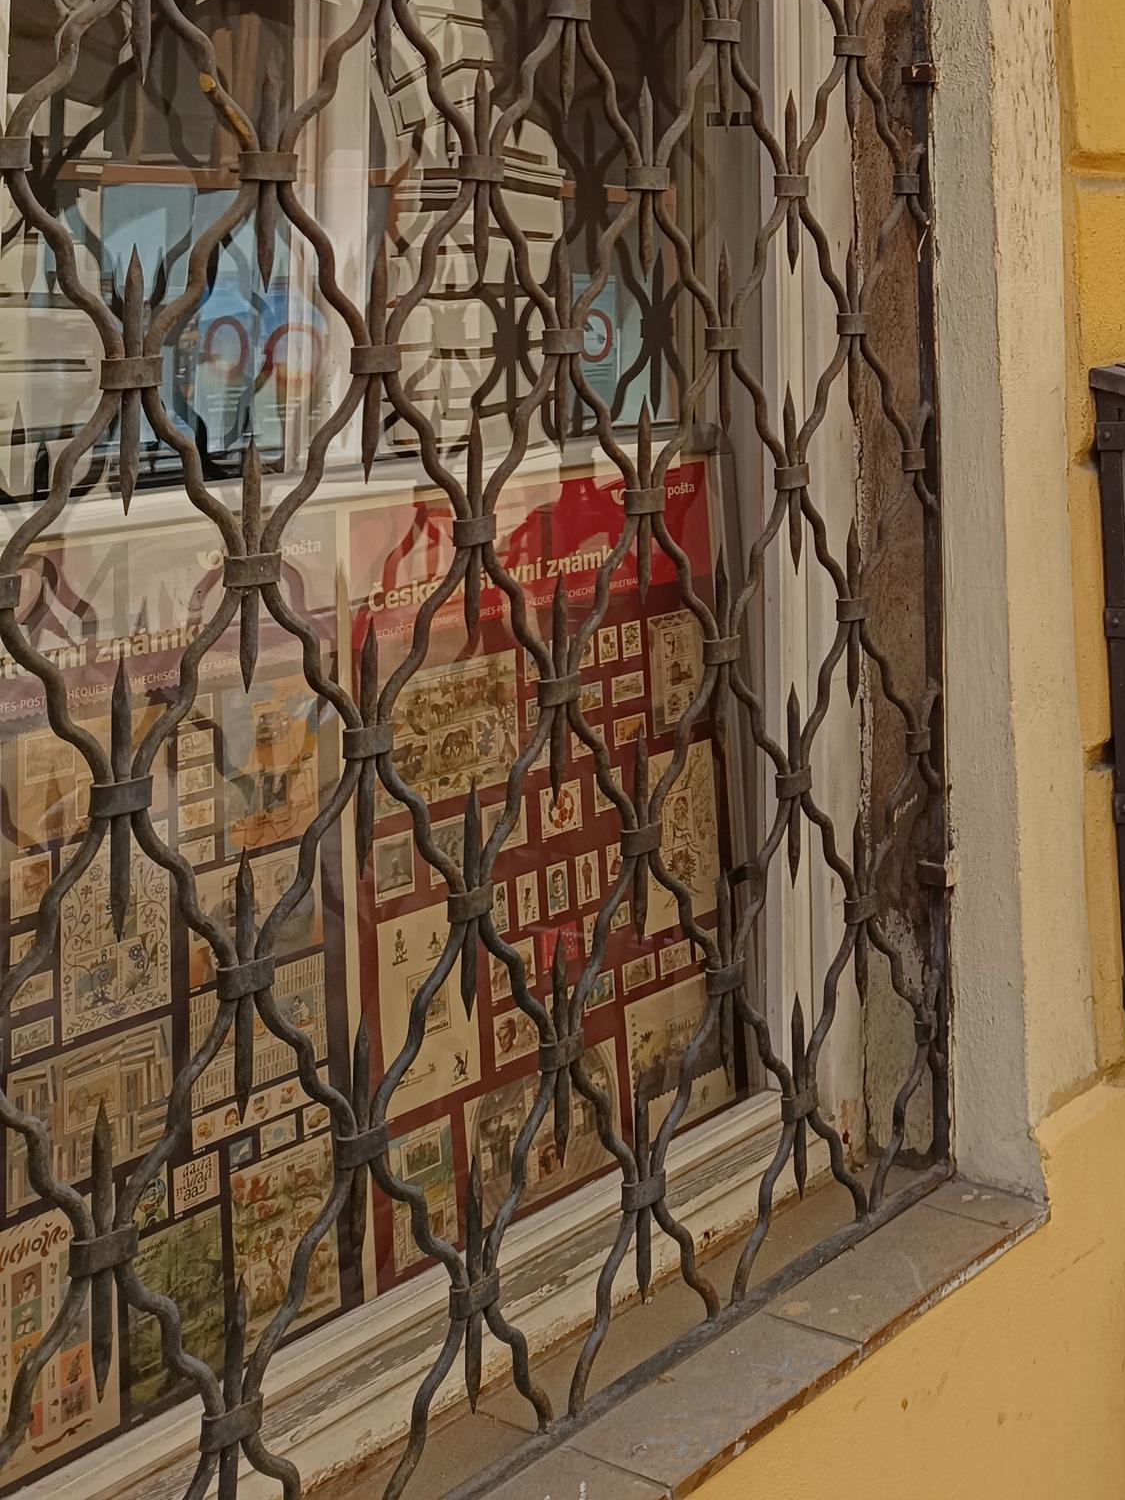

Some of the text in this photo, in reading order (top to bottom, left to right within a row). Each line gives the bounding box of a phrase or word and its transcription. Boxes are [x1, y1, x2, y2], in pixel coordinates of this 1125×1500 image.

[667, 481, 695, 499] pošta
[282, 539, 322, 558] pošta
[546, 545, 624, 578] známk
[95, 624, 205, 663] známk
